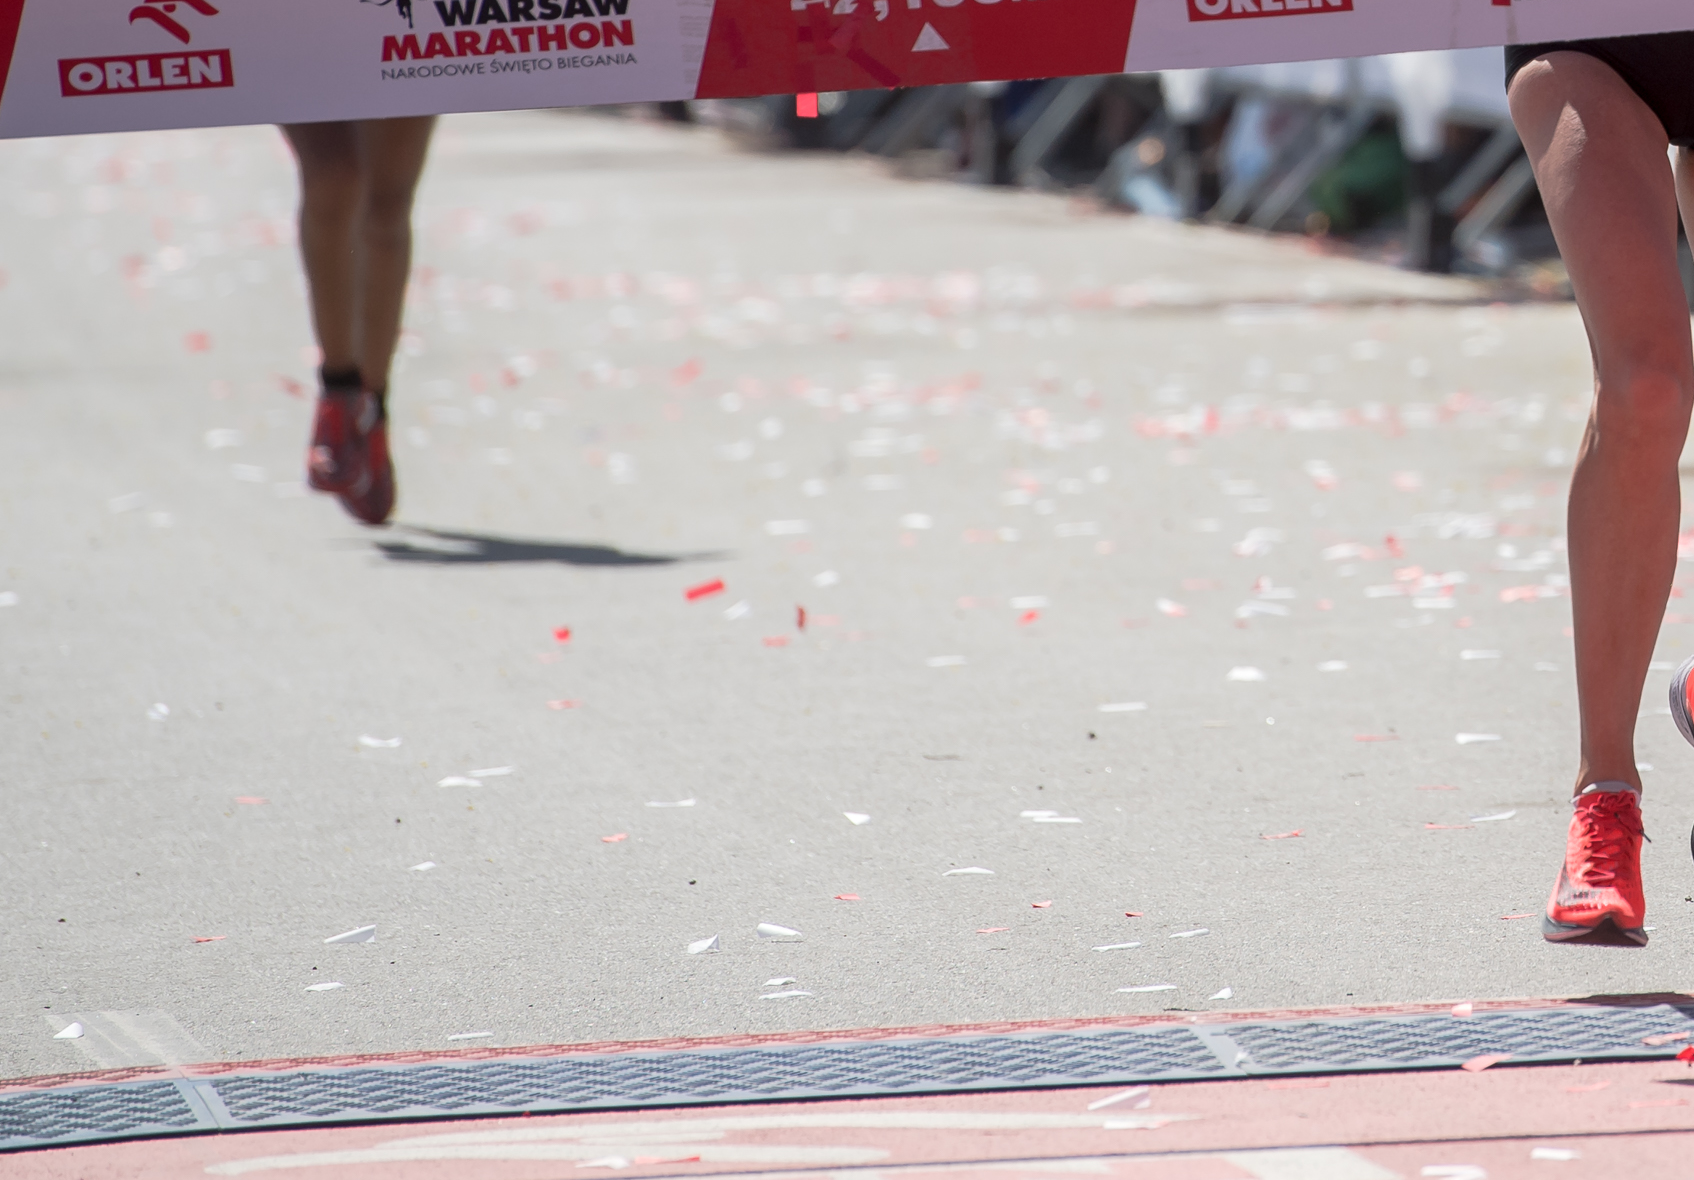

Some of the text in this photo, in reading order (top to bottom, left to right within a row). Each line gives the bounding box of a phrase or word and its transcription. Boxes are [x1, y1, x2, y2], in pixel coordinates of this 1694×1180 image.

[381, 19, 635, 62] MARATHON
[68, 54, 223, 92] ORLEN
[381, 53, 637, 80] NARODOWE ŚWIĘTO BIEGANIA
